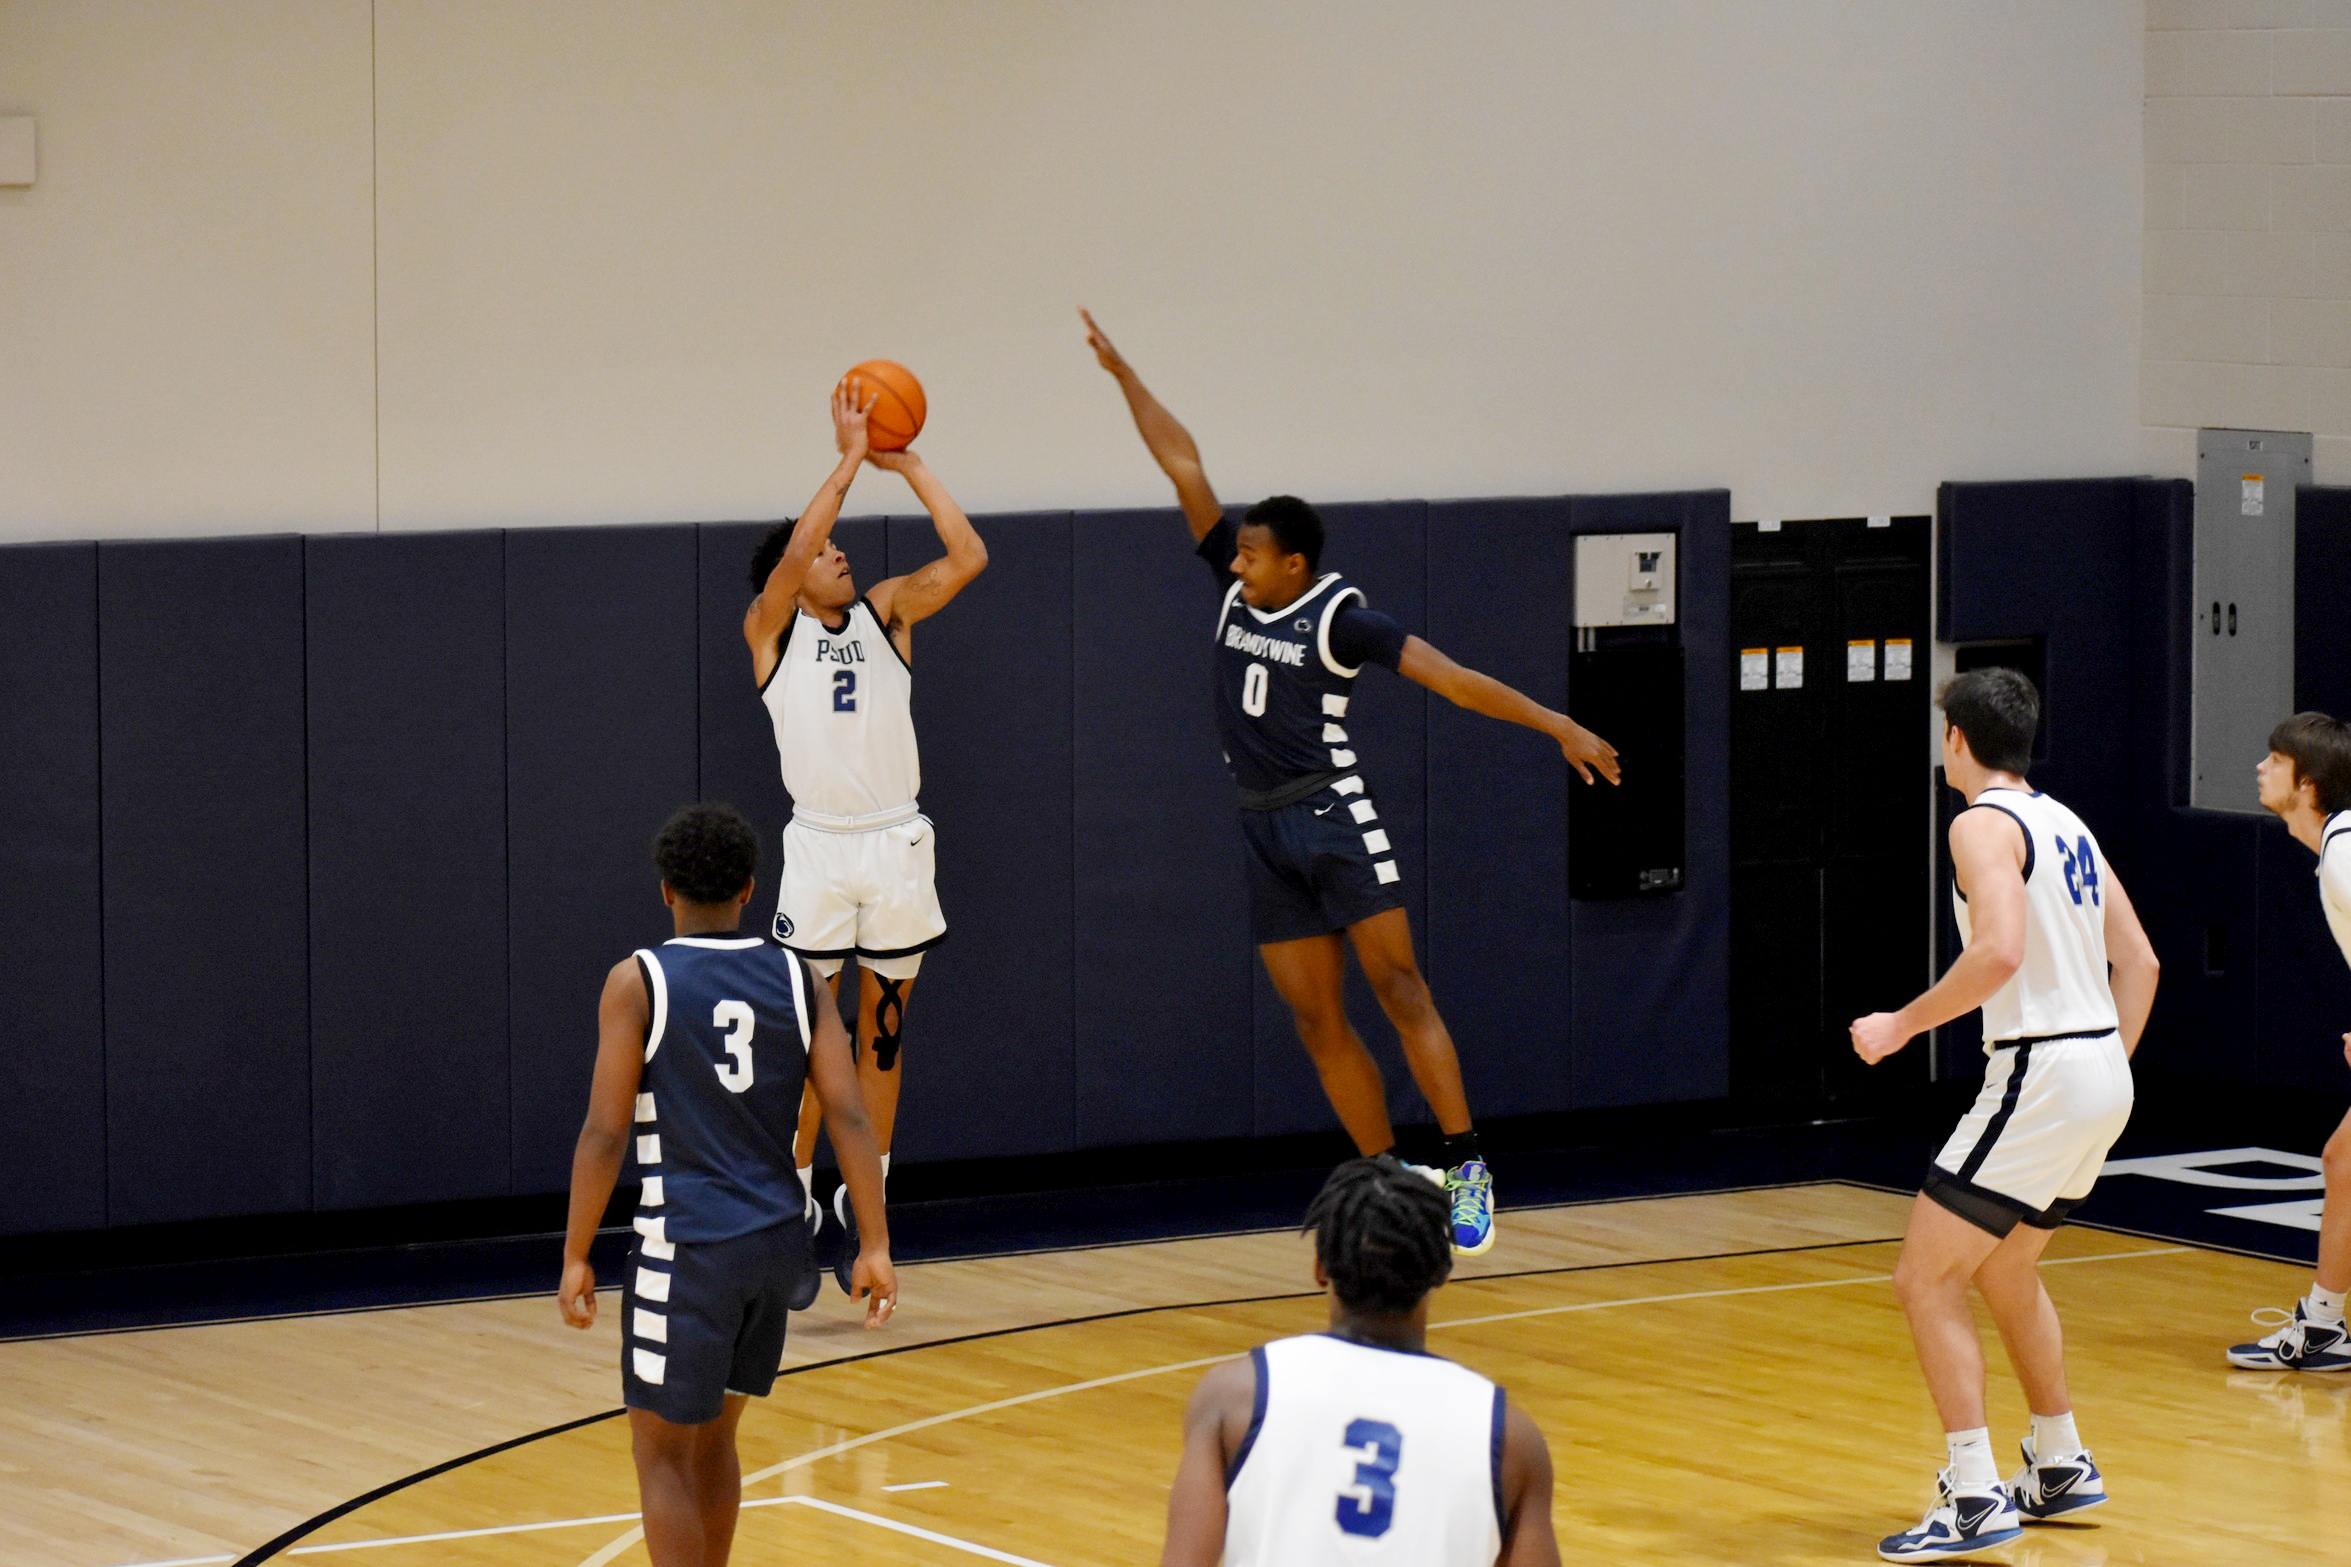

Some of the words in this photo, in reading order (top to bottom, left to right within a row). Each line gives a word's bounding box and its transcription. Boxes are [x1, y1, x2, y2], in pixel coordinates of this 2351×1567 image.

[833, 670, 856, 712] 2
[1242, 662, 1269, 718] 0
[2055, 834, 2099, 907] 24
[713, 999, 756, 1094] 3
[1335, 1417, 1403, 1539] 3
